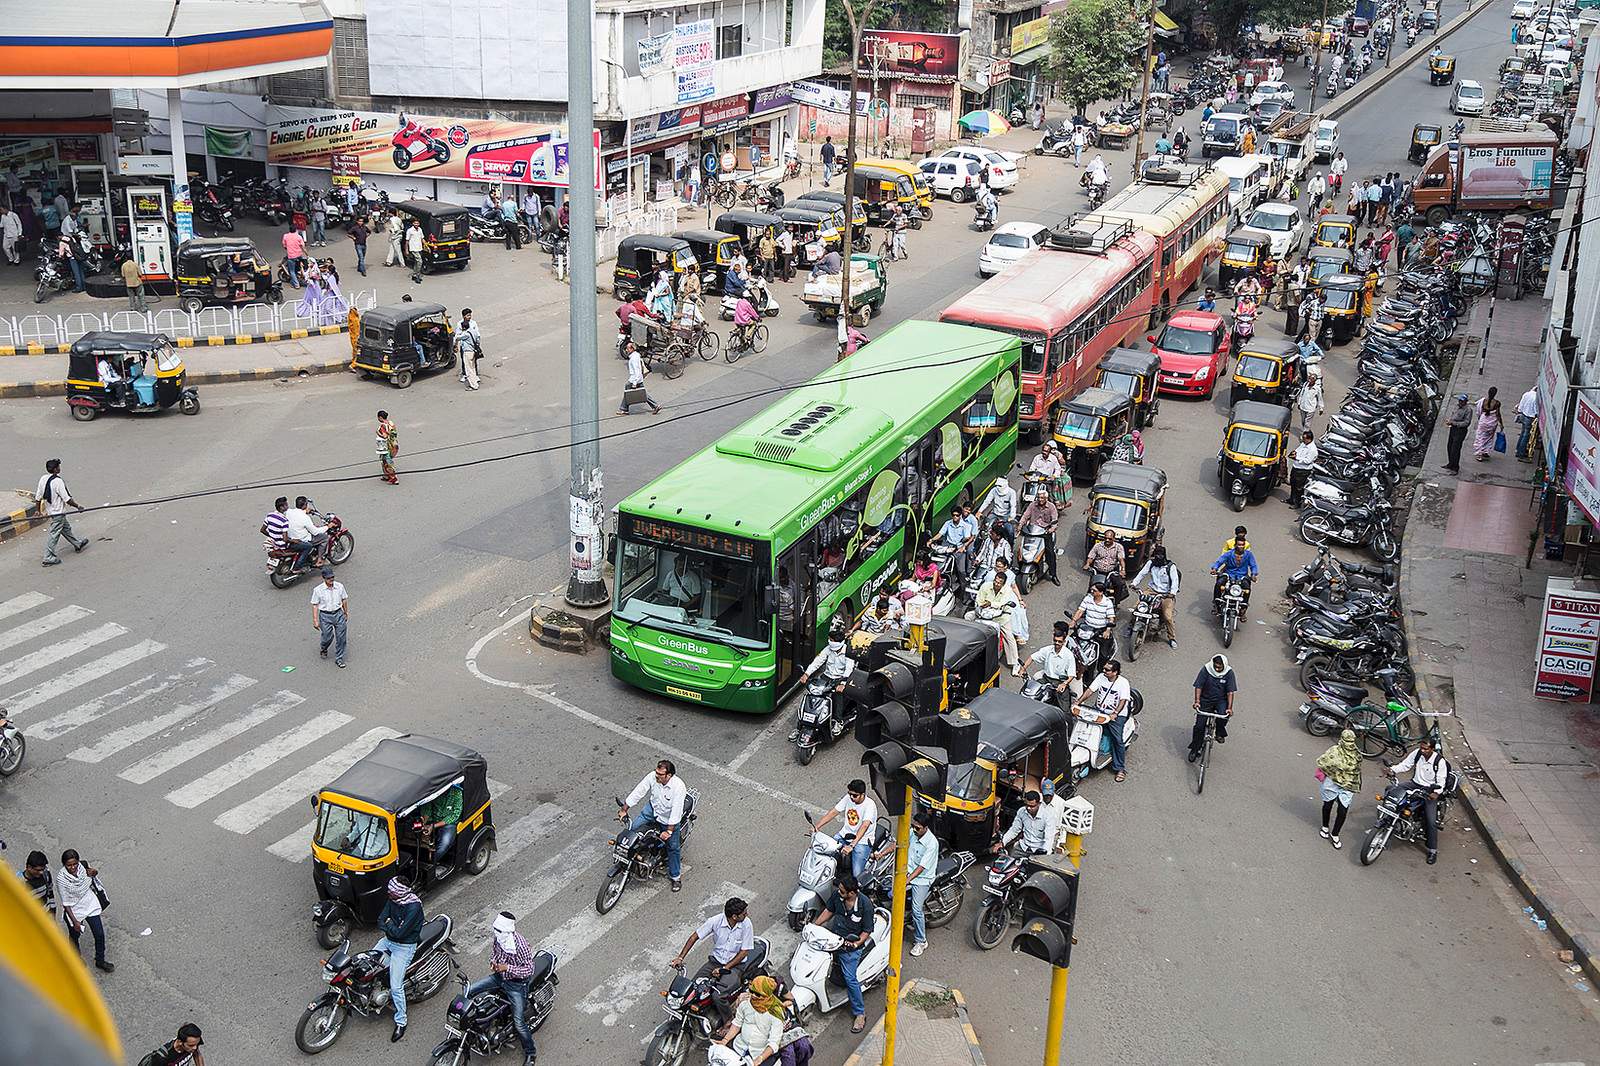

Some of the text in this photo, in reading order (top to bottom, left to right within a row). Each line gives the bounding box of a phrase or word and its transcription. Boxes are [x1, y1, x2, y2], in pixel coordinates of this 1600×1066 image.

[792, 81, 820, 95] CASIO
[279, 120, 299, 129] SERVO
[309, 116, 319, 124] OIL
[320, 114, 338, 123] KEEPS
[338, 112, 356, 120] YOUR
[270, 117, 378, 145] ENGINE, CLUTCH & GEAR
[328, 135, 354, 144] SUPERFIT
[1469, 147, 1546, 157] Eros Furniture
[484, 161, 525, 174] SERVO 4T
[1495, 157, 1516, 166] Life
[800, 494, 836, 530] GreenBus
[872, 559, 898, 592] SCANIA
[1564, 601, 1598, 613] TITAN
[1550, 625, 1595, 635] fastrack
[658, 635, 709, 655] GreenBus
[1554, 640, 1591, 649] SONATA
[663, 658, 700, 672] SCANIA
[1544, 657, 1592, 673] CASIO
[1545, 668, 1588, 676] CALCULATOR
